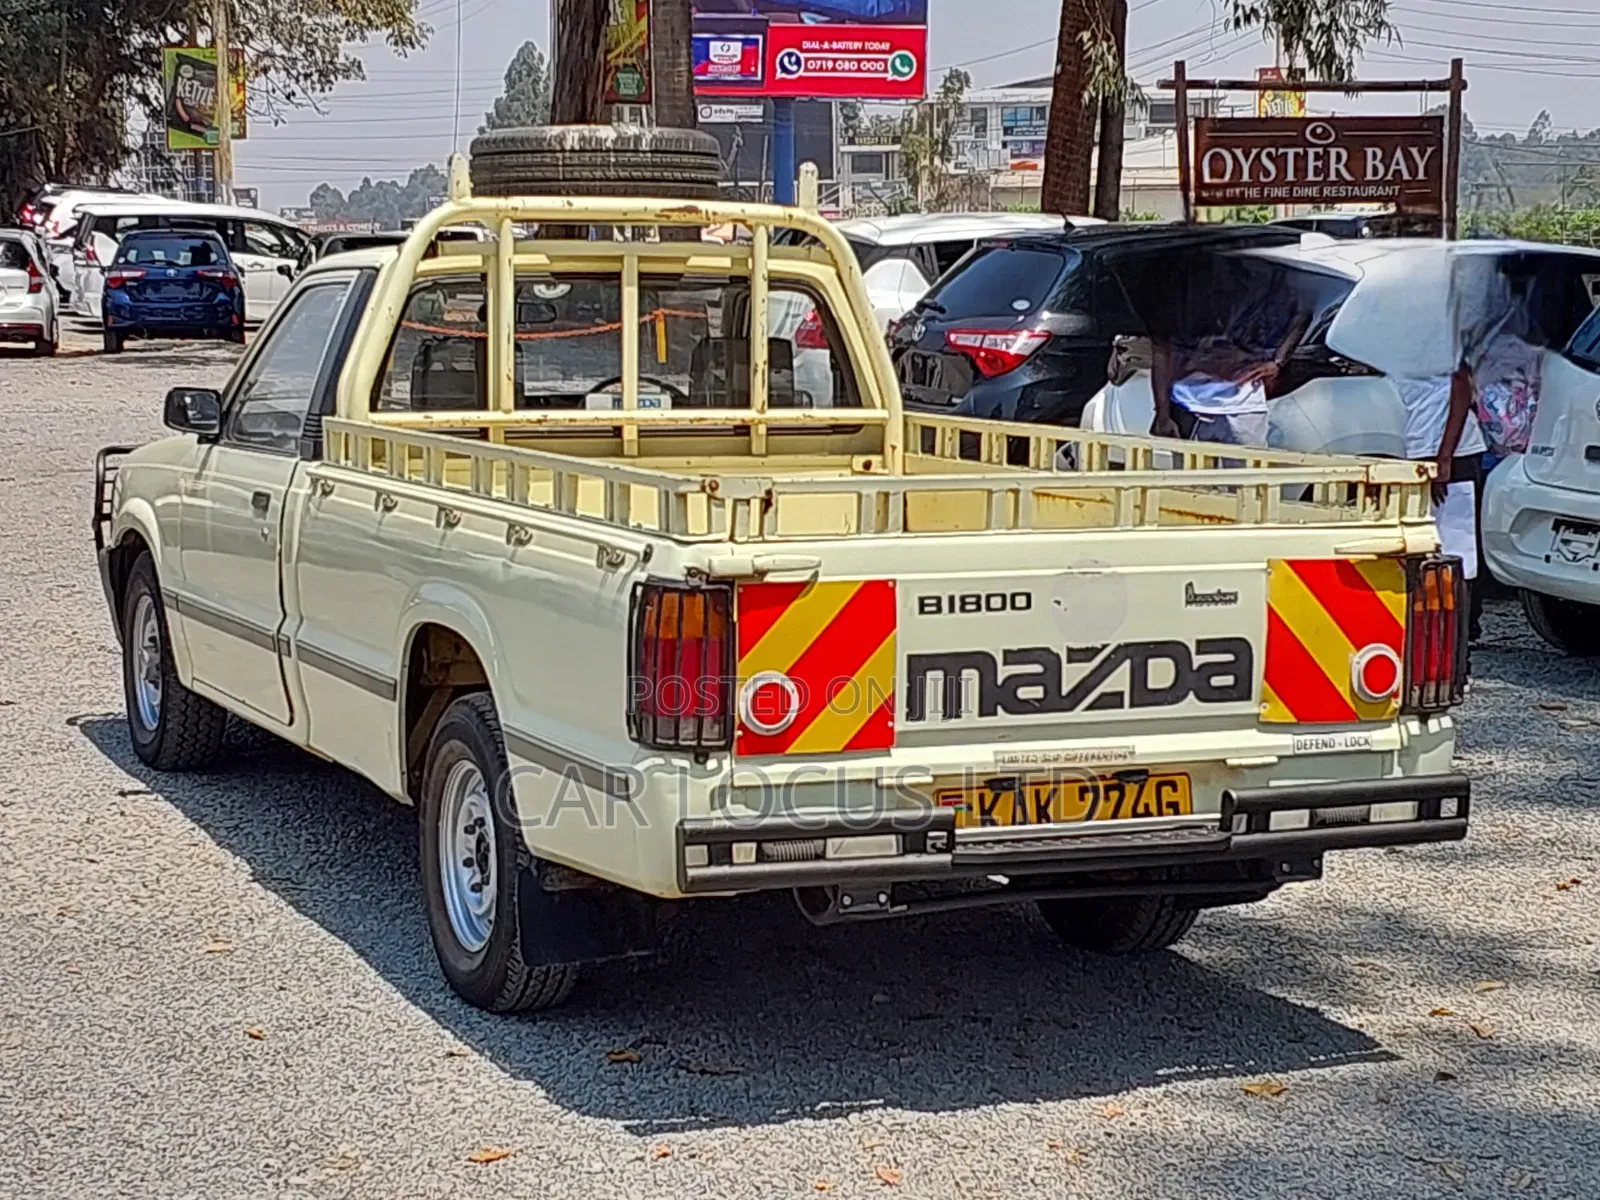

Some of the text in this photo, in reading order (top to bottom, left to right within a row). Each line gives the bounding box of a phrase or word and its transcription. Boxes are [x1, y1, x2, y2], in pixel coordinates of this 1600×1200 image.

[802, 40, 890, 51] DIAL-A-BATTERY TODAY
[807, 60, 833, 70] 0719
[860, 61, 885, 71] 000
[1202, 145, 1436, 183] OYSTER BAY
[1263, 186, 1291, 198] FINE
[1292, 186, 1320, 198] DINE
[1322, 185, 1400, 197] RESTAURANT
[917, 591, 1032, 615] B1800
[1296, 738, 1336, 751] DEFEND
[1344, 736, 1371, 748] LOCK
